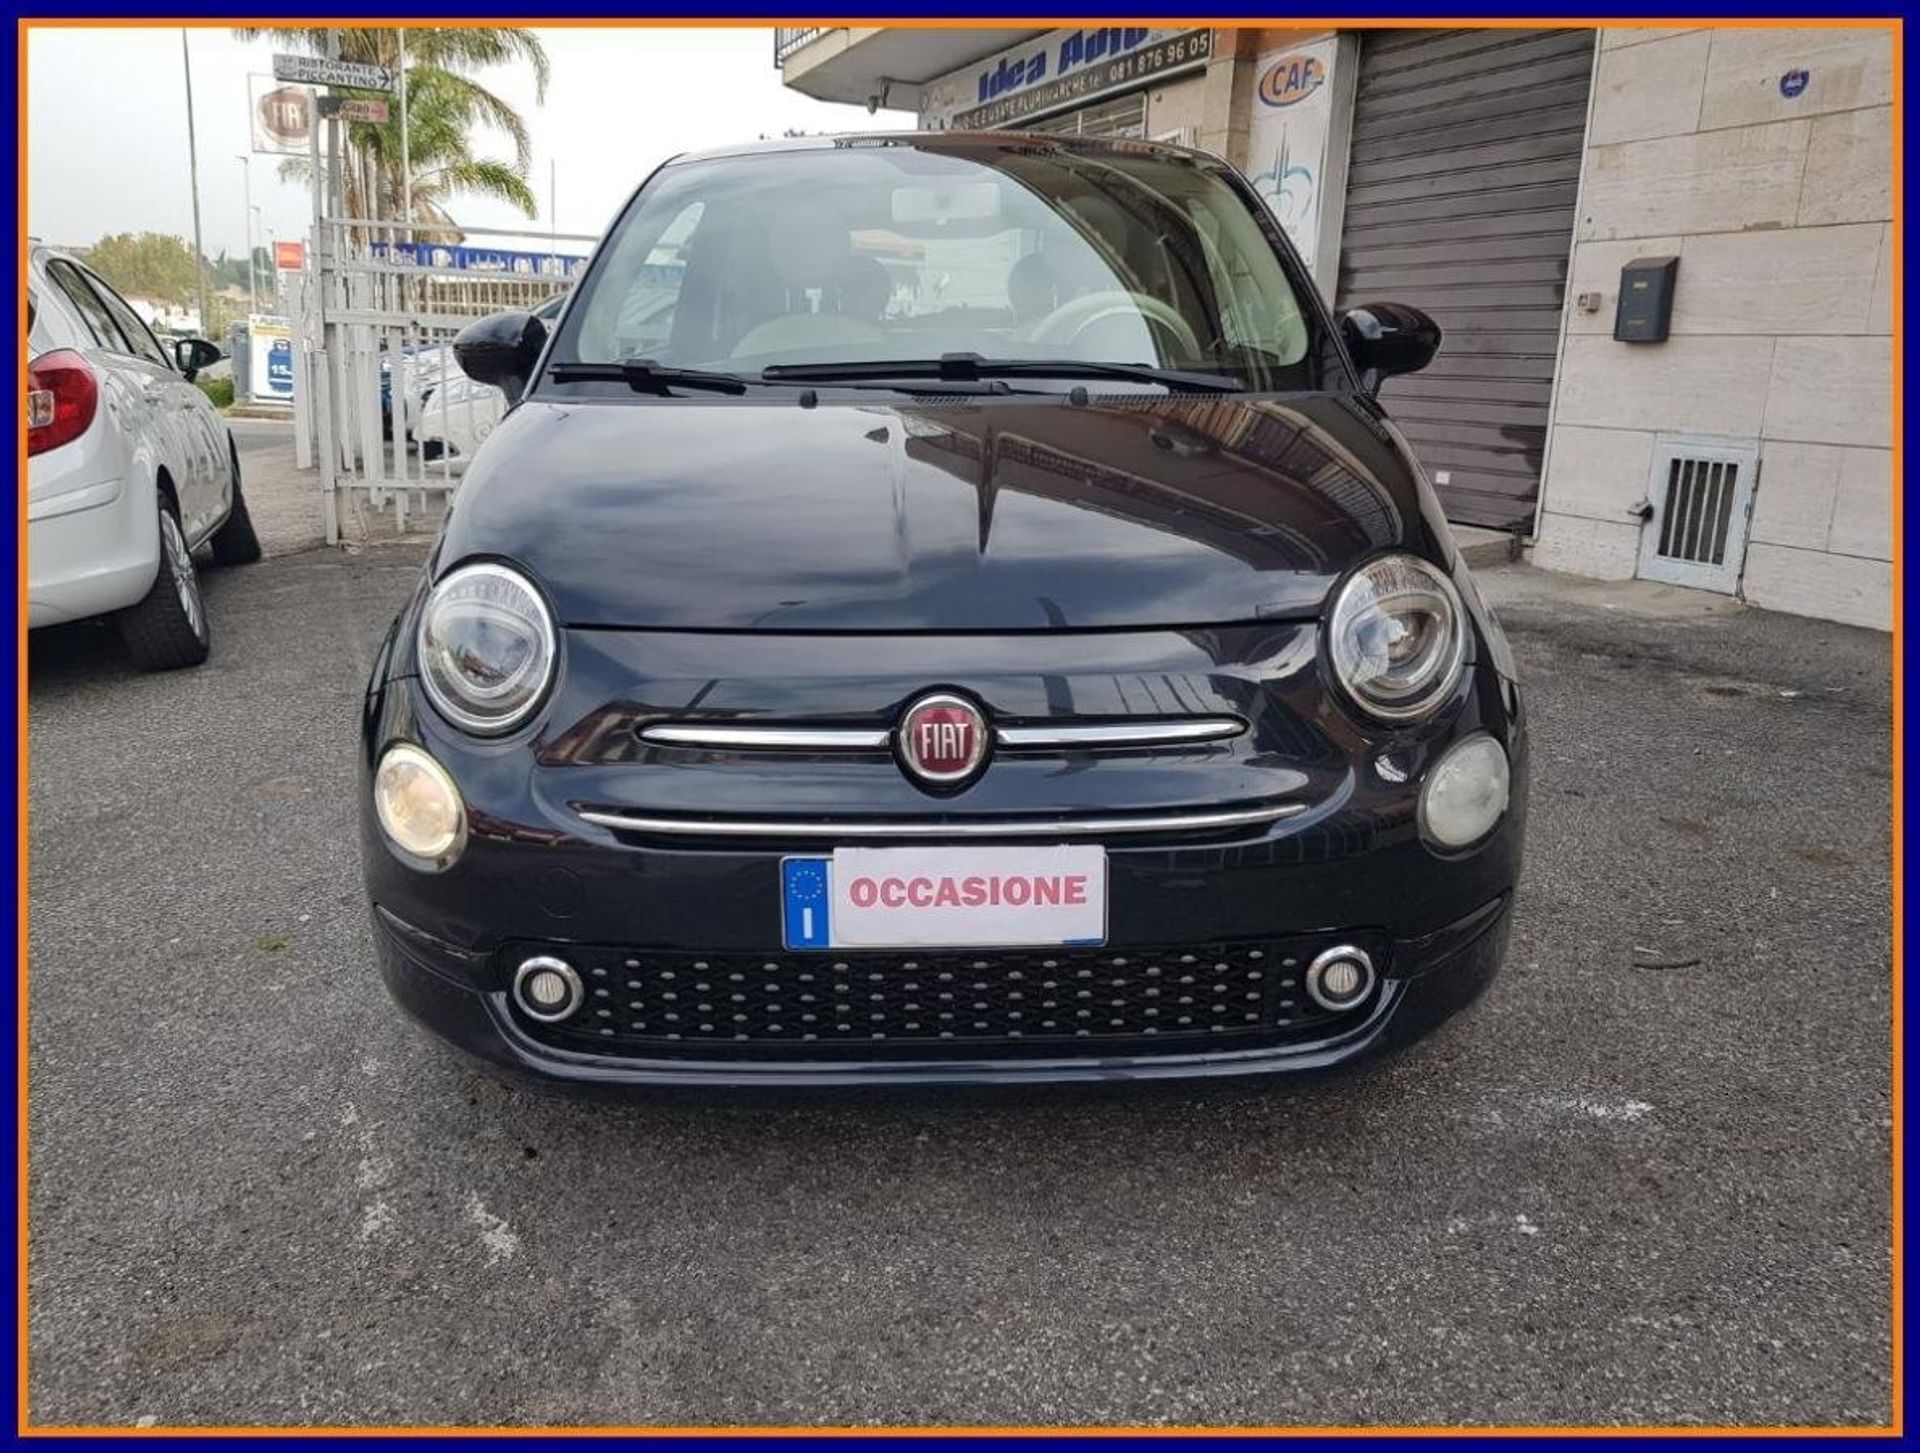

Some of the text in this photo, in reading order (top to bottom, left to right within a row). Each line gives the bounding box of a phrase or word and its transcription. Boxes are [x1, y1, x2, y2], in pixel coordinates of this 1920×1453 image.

[298, 57, 376, 75] RISTORANTE
[979, 28, 1149, 102] Idea Auto
[1109, 60, 1133, 81] 081
[1137, 48, 1164, 73] 876
[1167, 42, 1185, 63] 96
[1189, 33, 1209, 55] 05
[298, 69, 377, 86] PICCANTINO
[1271, 57, 1316, 96] CAF
[921, 722, 969, 760] FIAT
[849, 875, 1088, 908] OCCASIONE
[803, 907, 813, 939] I
